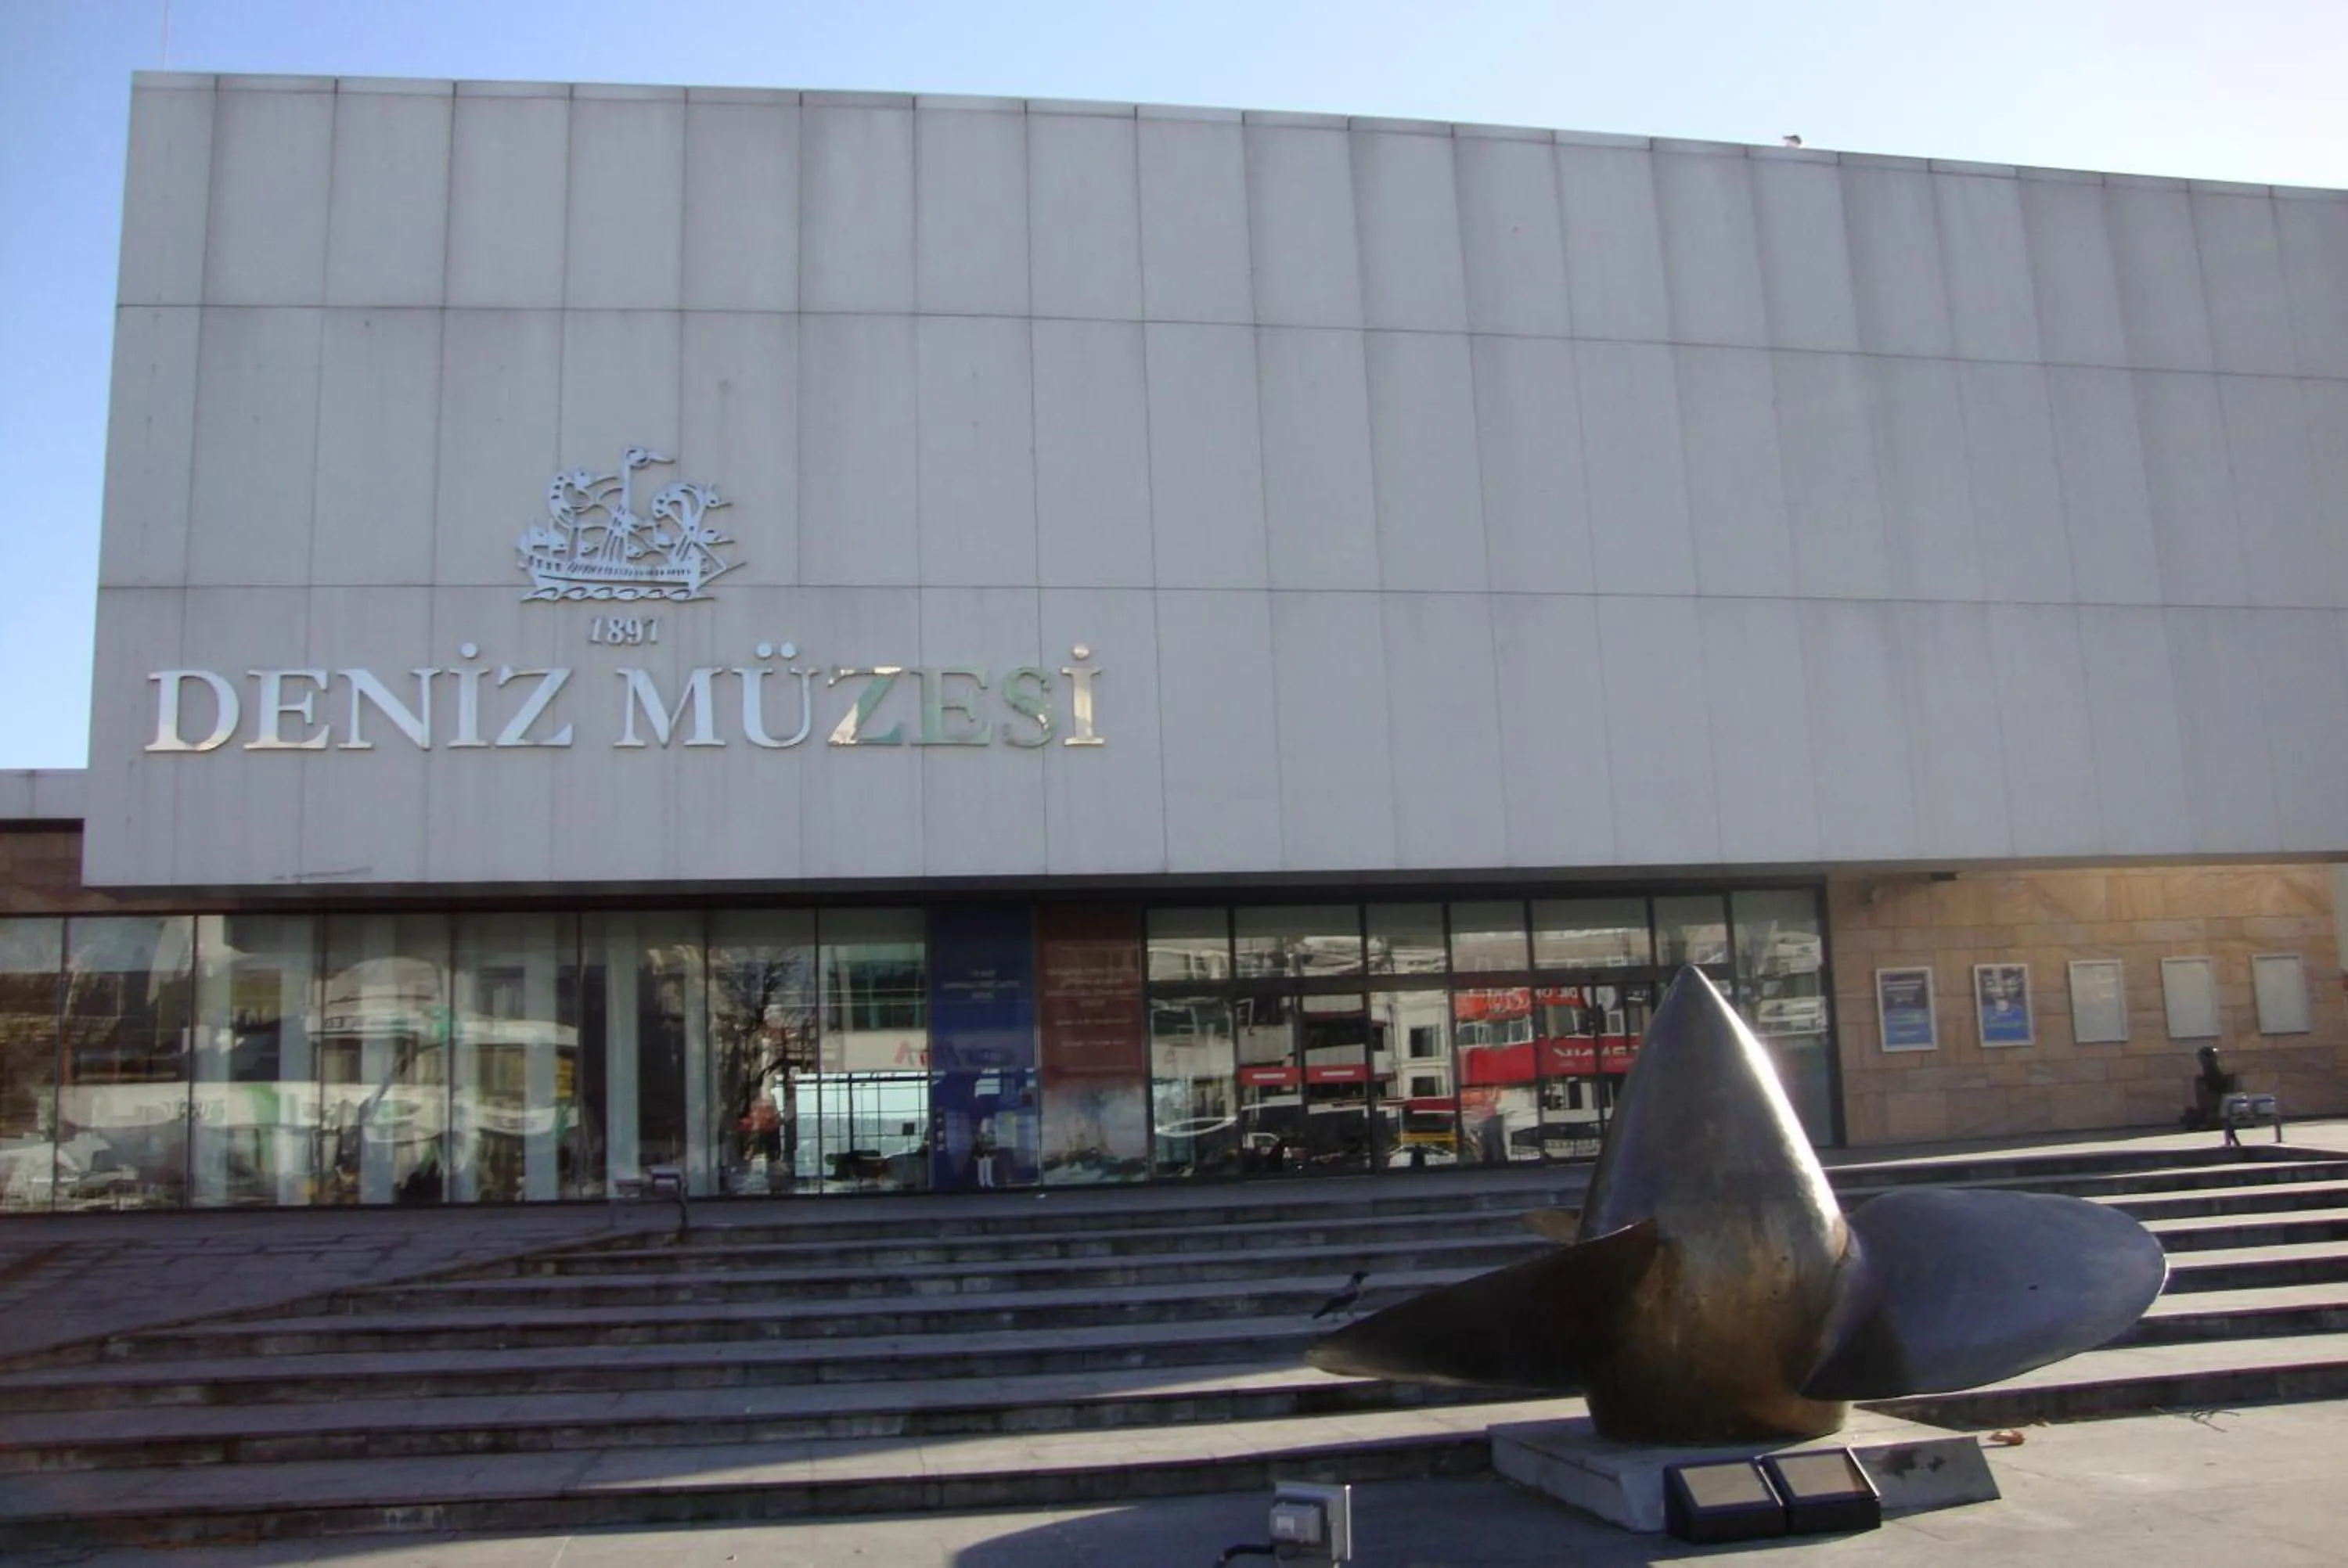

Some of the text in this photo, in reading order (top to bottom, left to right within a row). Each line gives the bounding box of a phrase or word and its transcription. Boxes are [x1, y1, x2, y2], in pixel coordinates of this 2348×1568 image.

[589, 617, 659, 645] 1897
[144, 641, 1105, 751] DENİZ MÜZESİ
